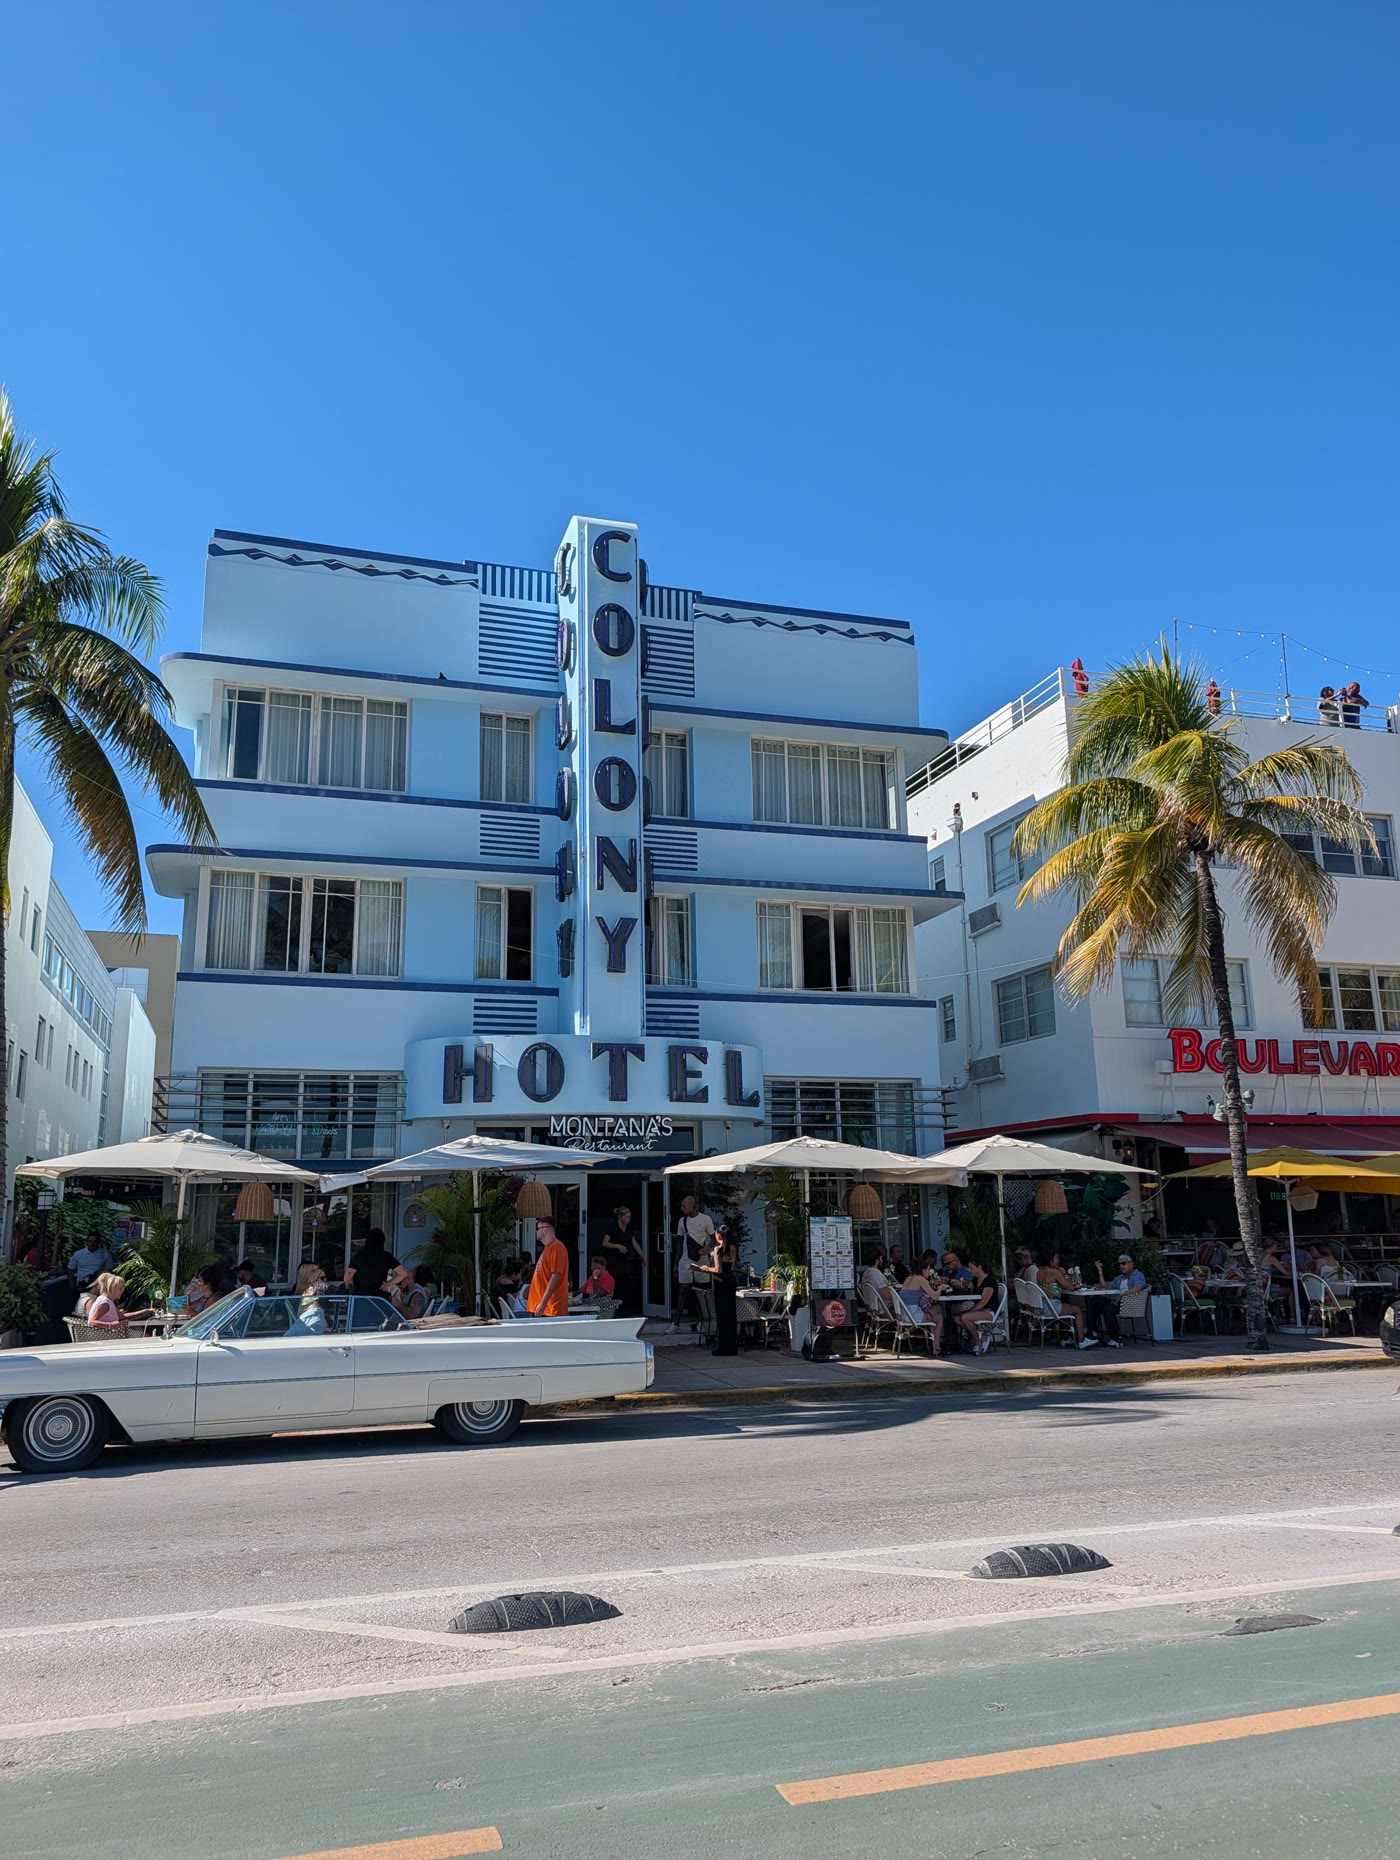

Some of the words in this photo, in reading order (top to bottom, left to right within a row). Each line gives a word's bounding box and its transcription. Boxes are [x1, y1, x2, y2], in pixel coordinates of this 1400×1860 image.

[592, 529, 637, 973] COLONY
[443, 1042, 760, 1107] HOTEL
[550, 1115, 673, 1137] MONTANA'S
[563, 1136, 658, 1152] Restaurant
